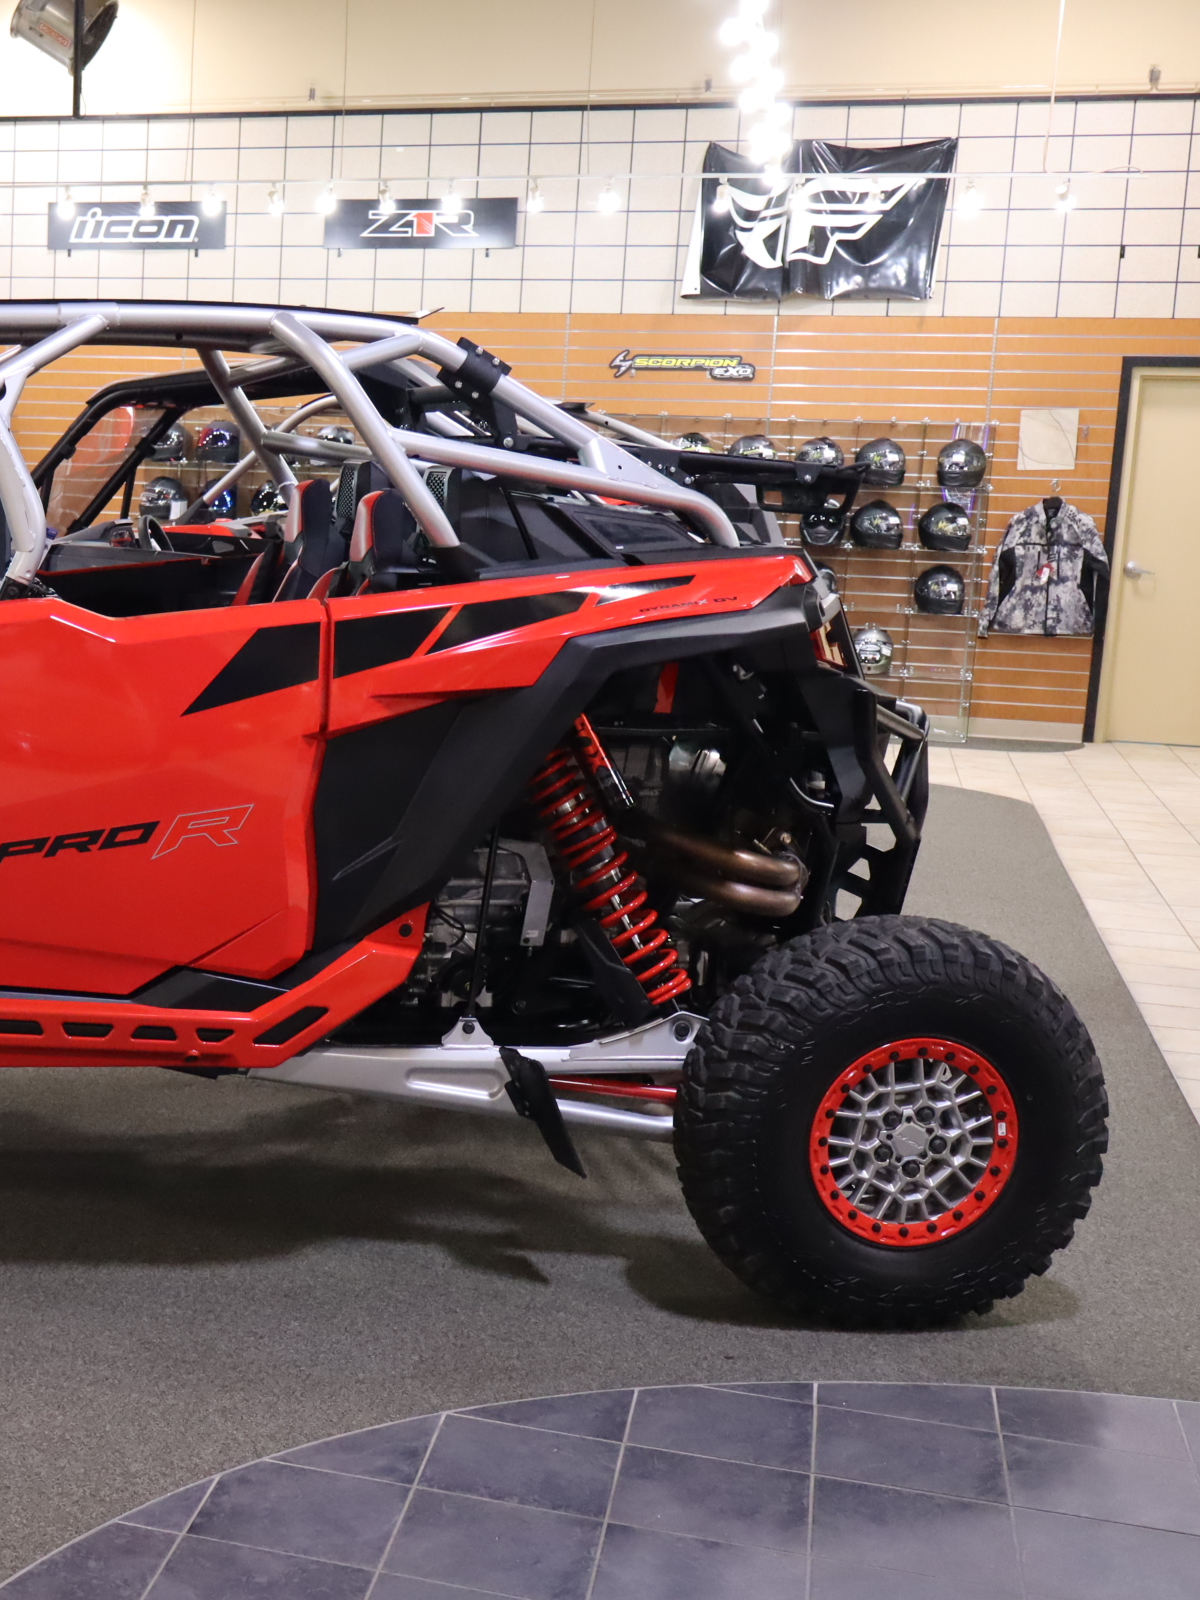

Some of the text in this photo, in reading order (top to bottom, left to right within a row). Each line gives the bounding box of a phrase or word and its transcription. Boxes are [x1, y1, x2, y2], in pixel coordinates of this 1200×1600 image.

[359, 209, 481, 237] Z1R
[632, 355, 741, 369] SCORPION
[638, 598, 708, 613] DYNAMIX
[151, 803, 256, 861] R
